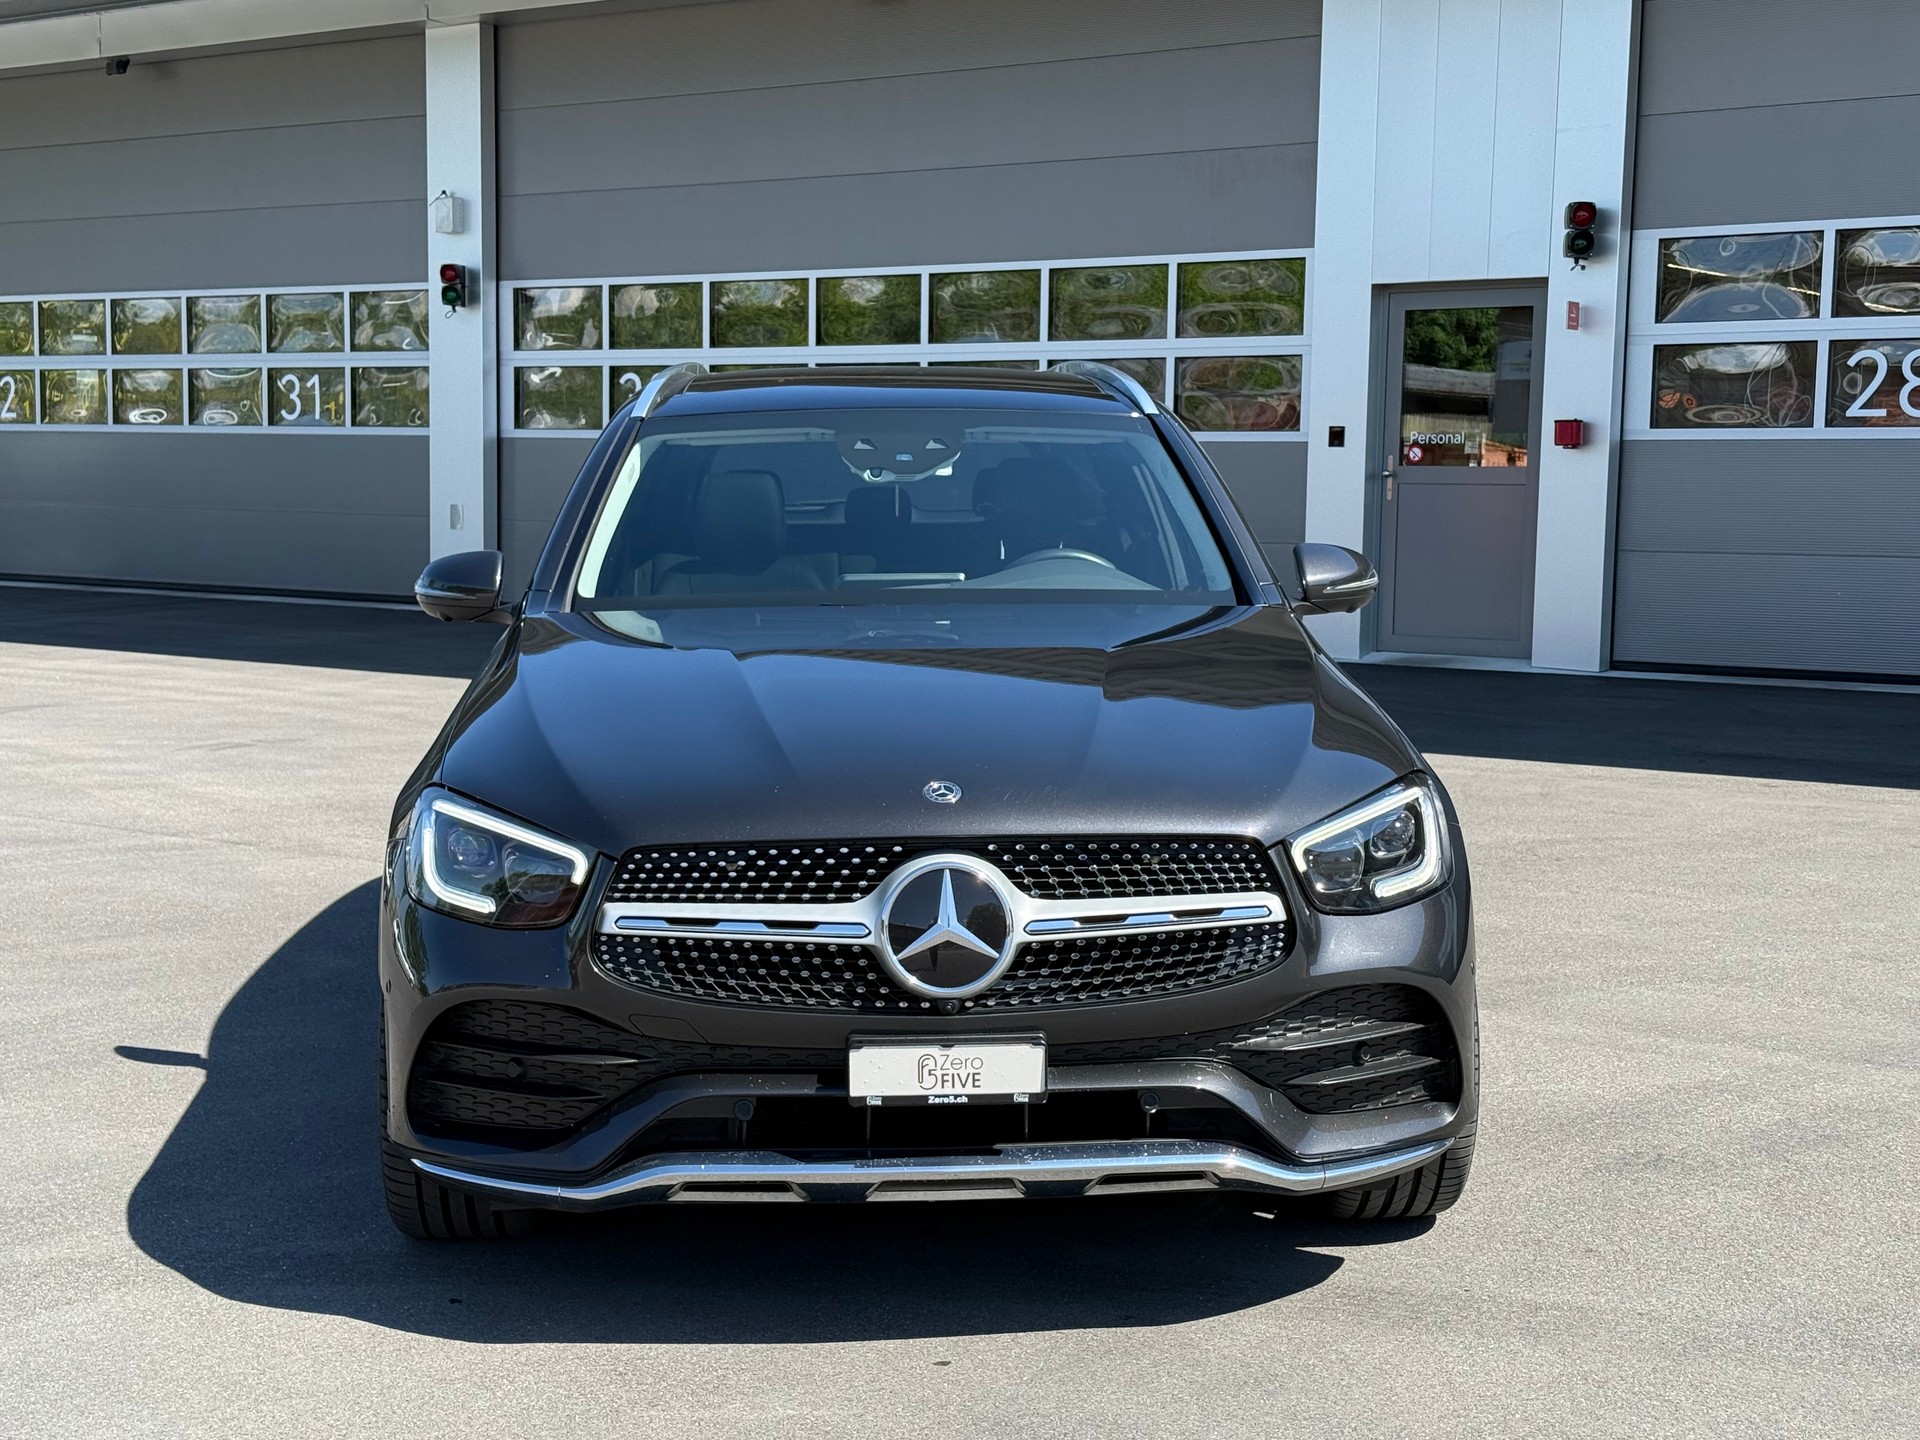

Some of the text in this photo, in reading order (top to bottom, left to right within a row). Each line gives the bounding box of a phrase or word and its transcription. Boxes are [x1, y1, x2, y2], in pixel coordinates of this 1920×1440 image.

[280, 373, 320, 420] 31
[1410, 431, 1465, 444] Personal
[939, 1054, 984, 1071] Zero
[940, 1072, 982, 1089] FIVE
[927, 1095, 969, 1104] Zero5.ch
